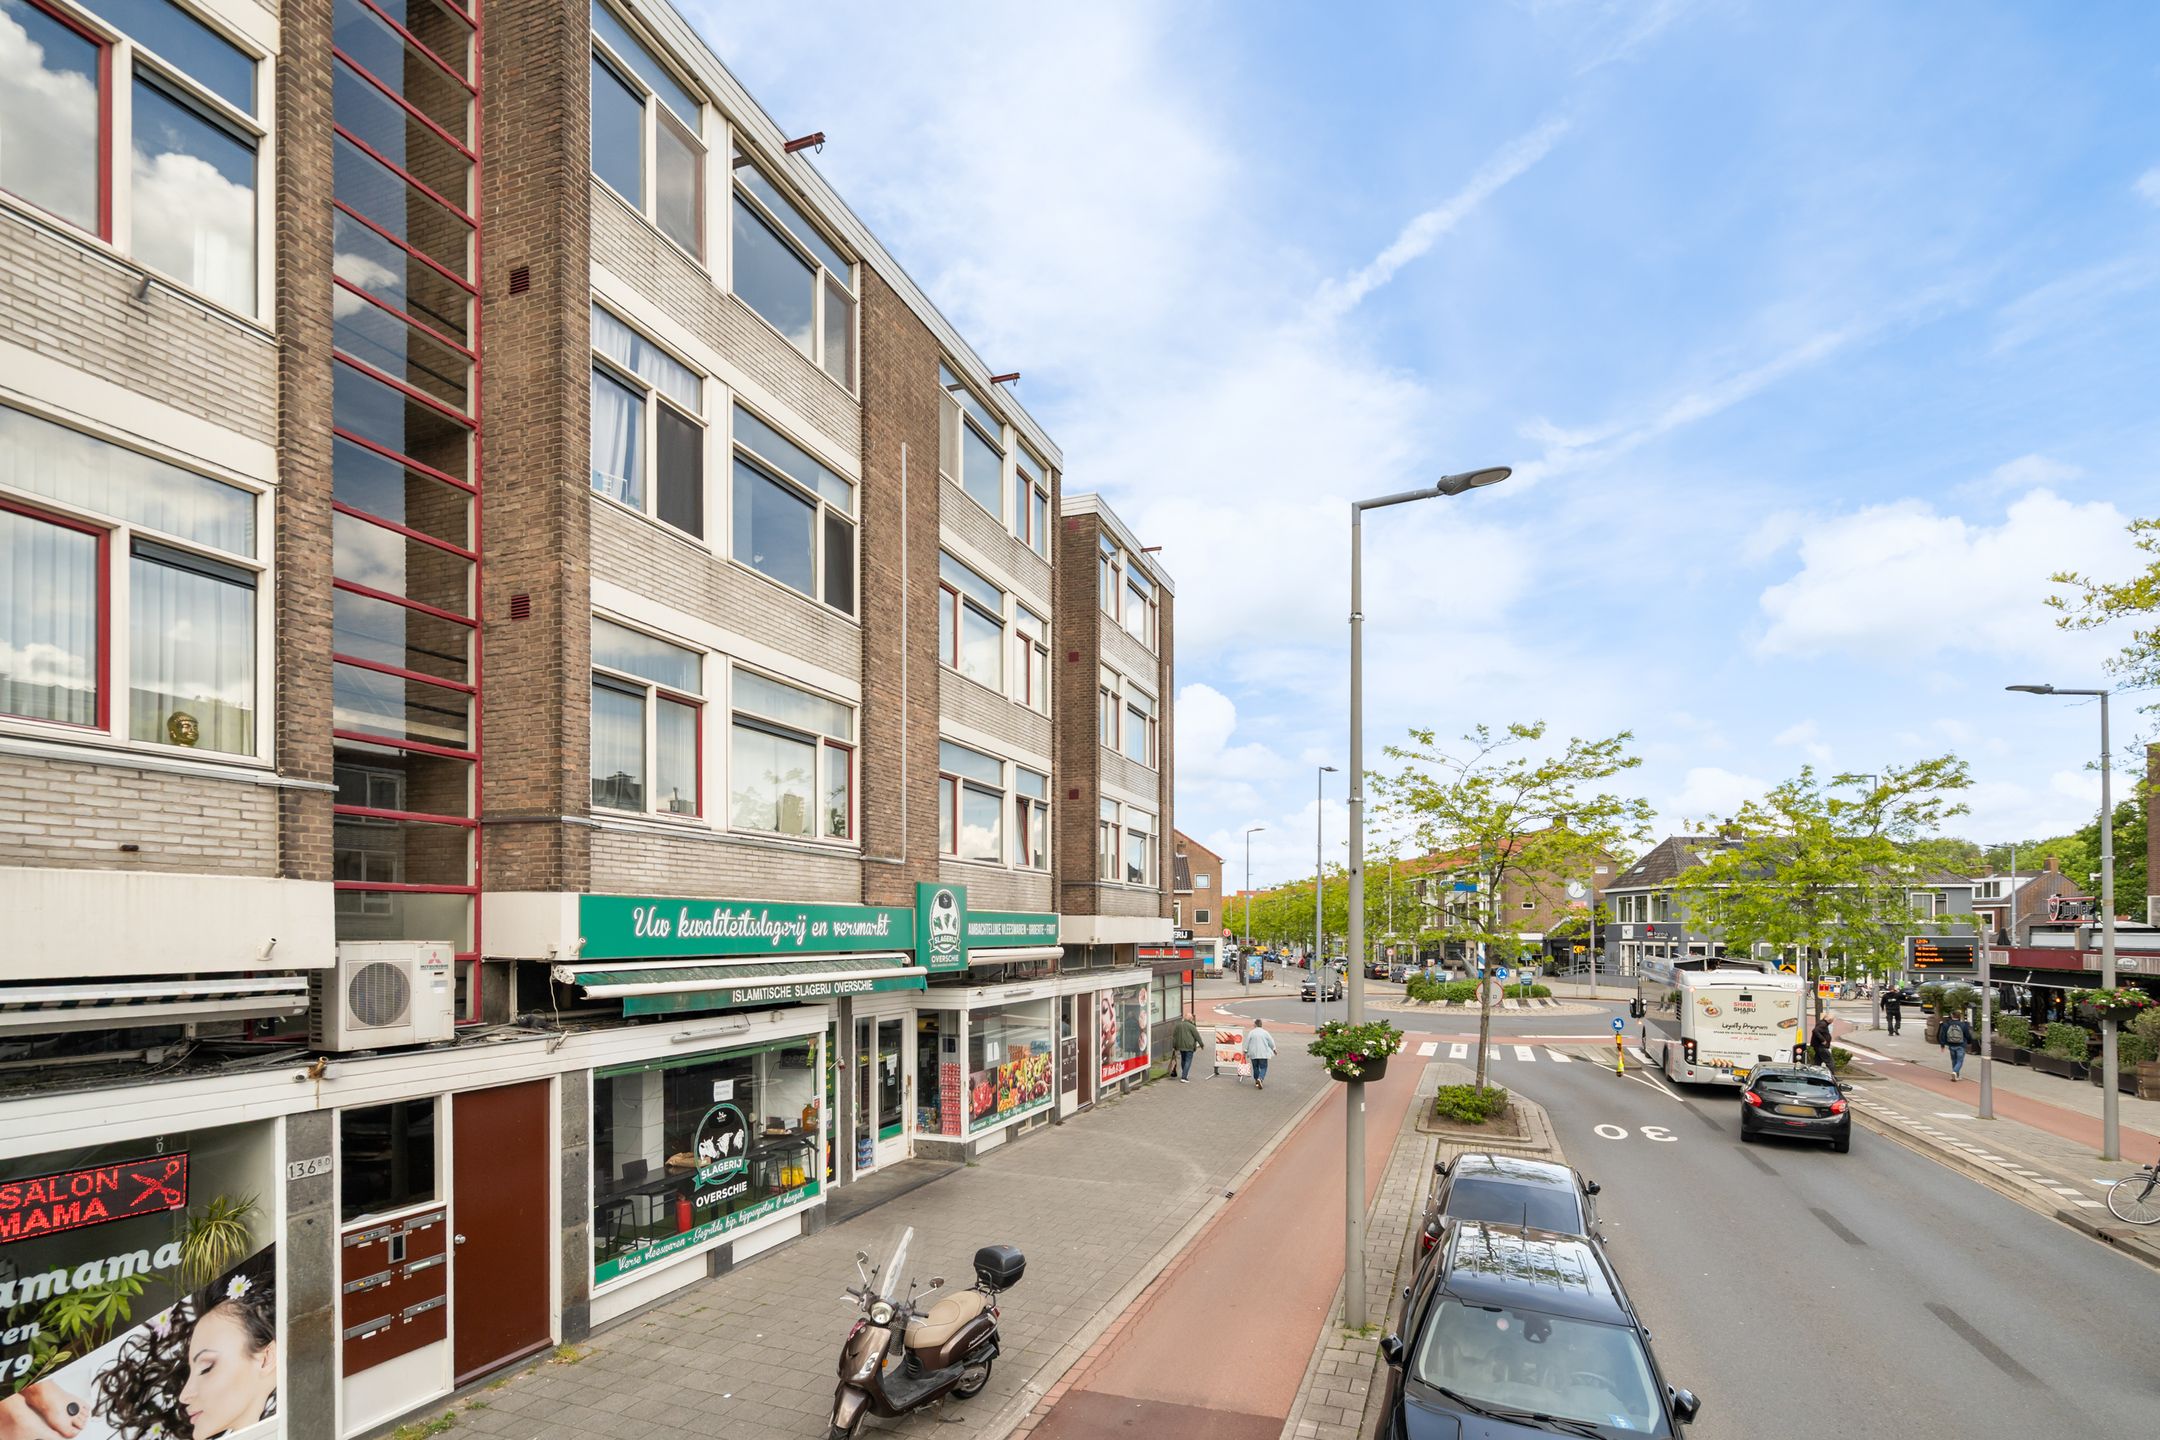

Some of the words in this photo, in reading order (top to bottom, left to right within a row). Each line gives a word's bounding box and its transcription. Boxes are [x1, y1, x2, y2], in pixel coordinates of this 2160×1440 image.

[633, 906, 671, 937] Uw
[677, 907, 807, 946] kwaliteitsslagerij
[811, 920, 828, 937] en
[833, 913, 892, 937] versmarkt
[934, 935, 957, 945] SLAGERIJ
[931, 954, 959, 964] OVERSCHIE
[732, 985, 792, 1003] ISLAMITISCHE
[794, 981, 831, 997] SLAGERIJ
[834, 980, 874, 993] OVERSCHIE
[290, 1160, 316, 1178] 136
[700, 1158, 742, 1180] SLAGERIJ
[0, 1169, 118, 1210] SALON
[695, 1181, 747, 1208] OVERSCHIE
[0, 1197, 109, 1238] MAMA
[618, 1255, 642, 1271] Verse
[645, 1239, 685, 1261] vleeswaren
[0, 1322, 41, 1346] en
